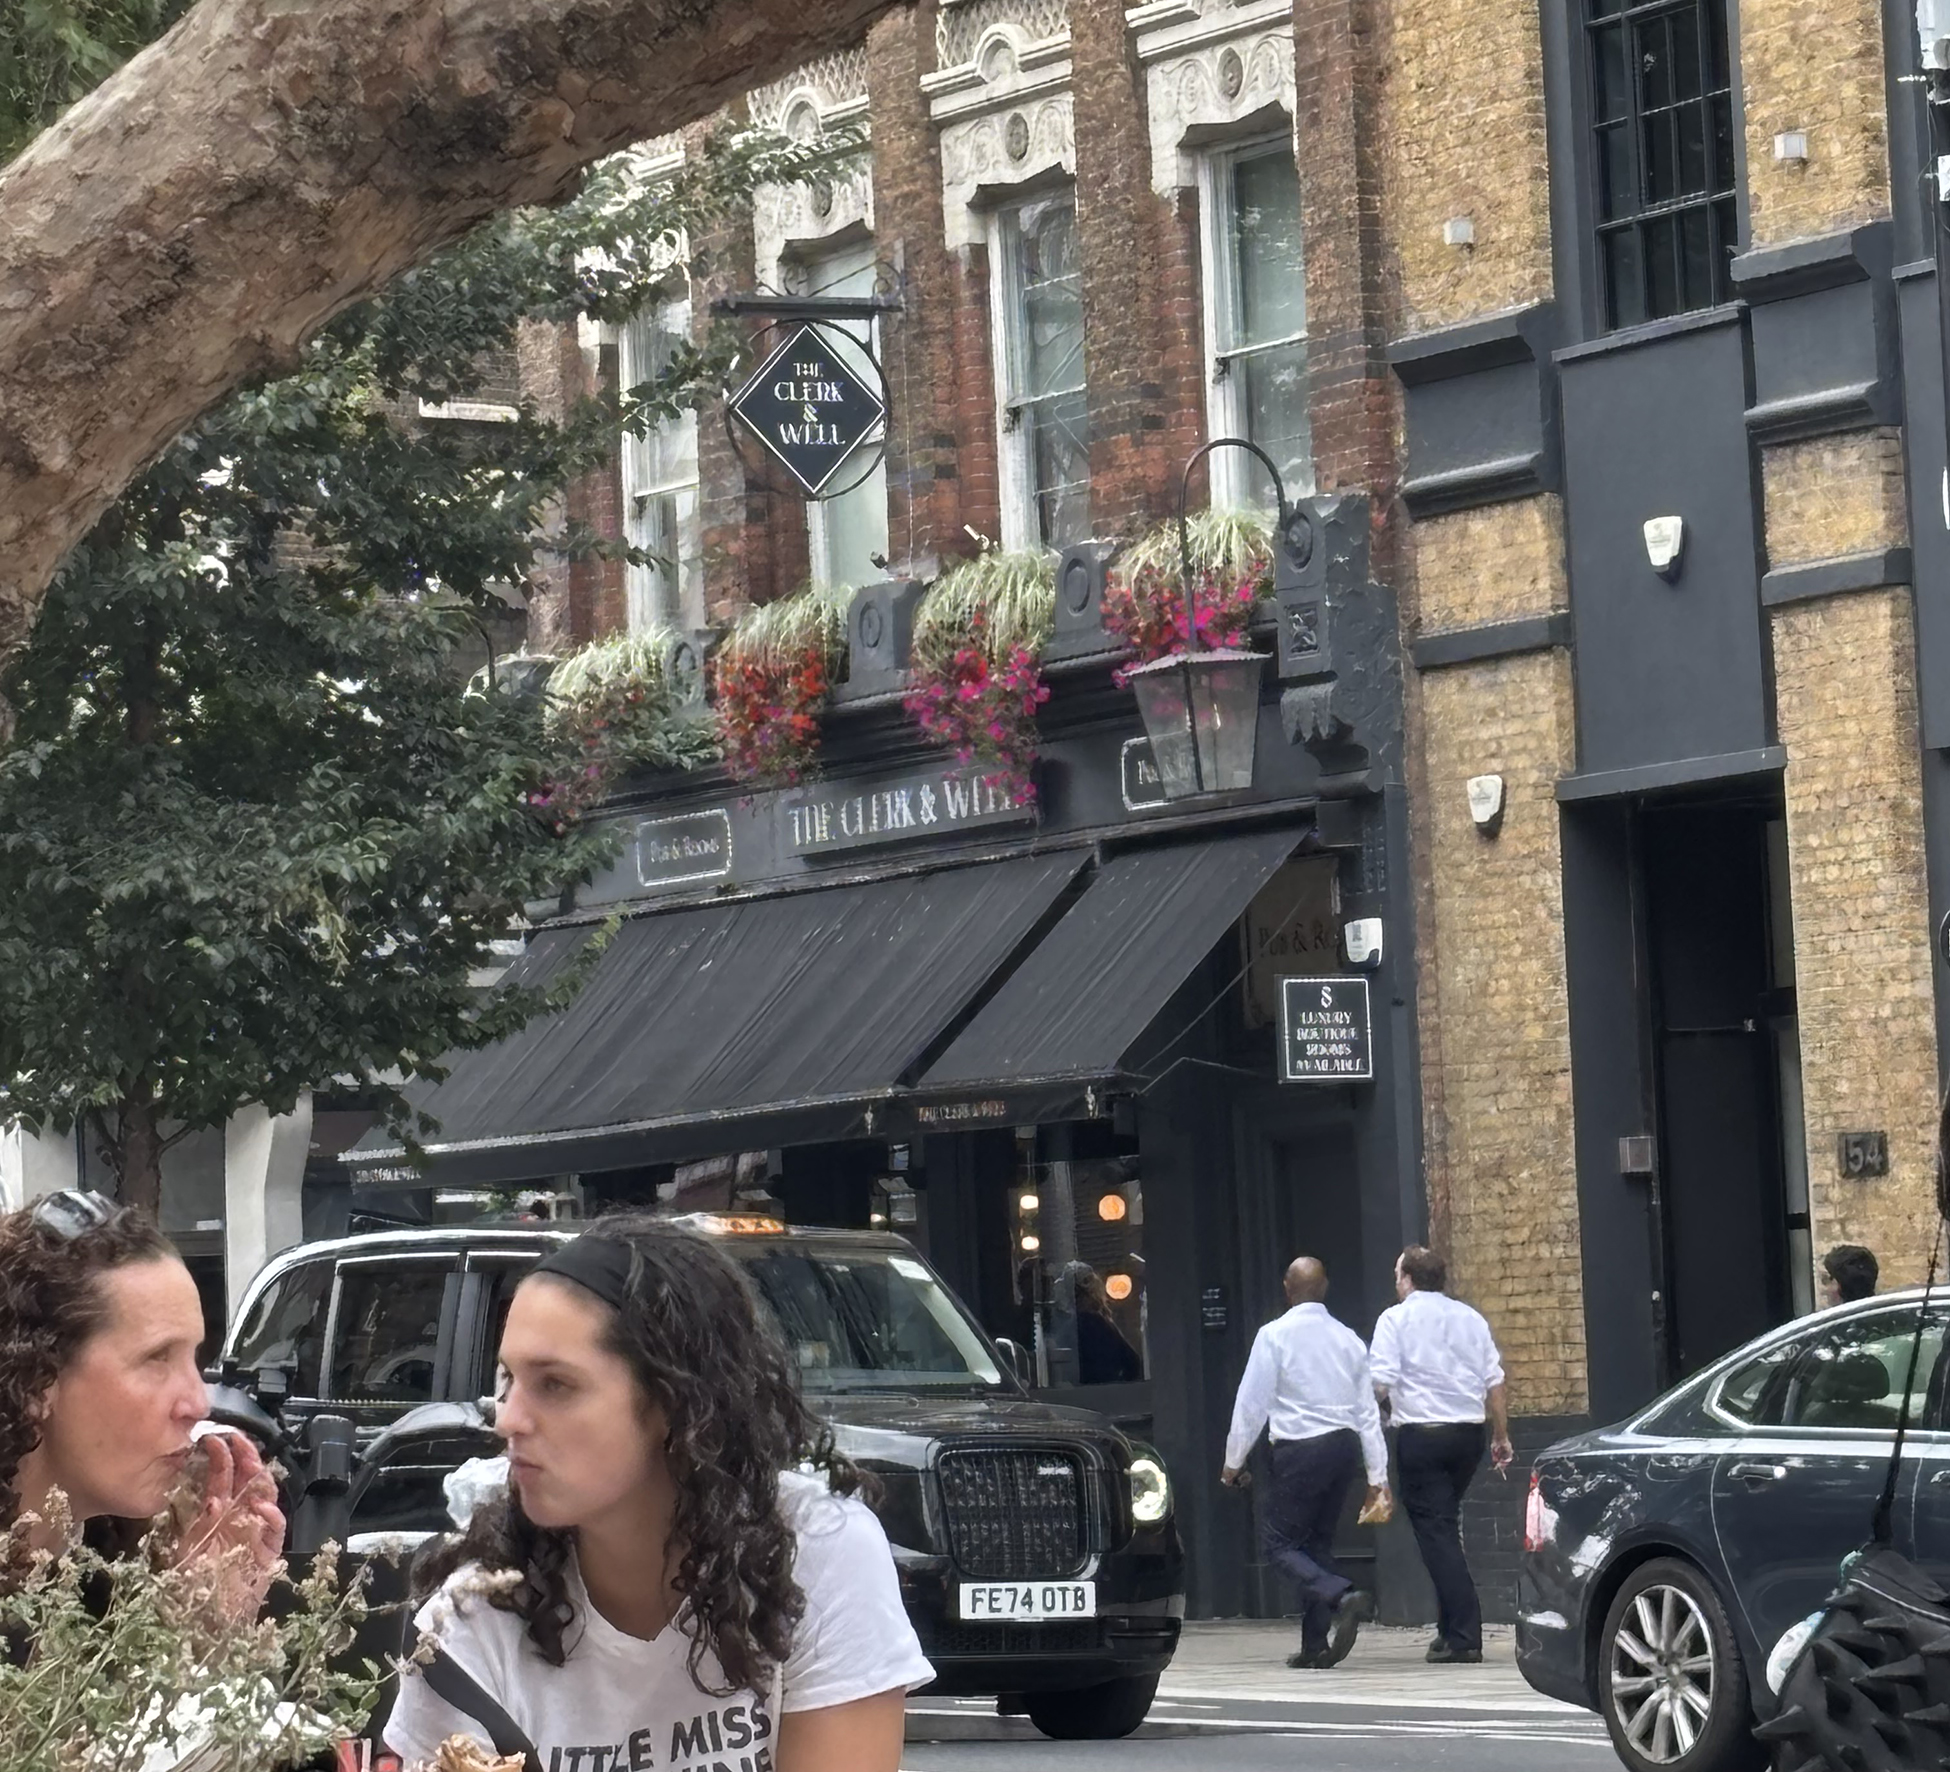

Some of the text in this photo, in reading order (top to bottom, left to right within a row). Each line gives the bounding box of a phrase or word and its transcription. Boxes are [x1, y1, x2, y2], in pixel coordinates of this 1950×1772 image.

[793, 362, 824, 378] THE
[773, 381, 844, 402] CLERK
[803, 403, 818, 422] &
[778, 422, 846, 445] WELL
[788, 801, 836, 846] THE
[841, 787, 916, 837] CLERK
[920, 783, 938, 825] &
[1847, 1138, 1884, 1173] 54
[971, 1586, 1086, 1614] FE74 OTB
[547, 1727, 654, 1772] ITTLE
[670, 1703, 772, 1763] MISS
